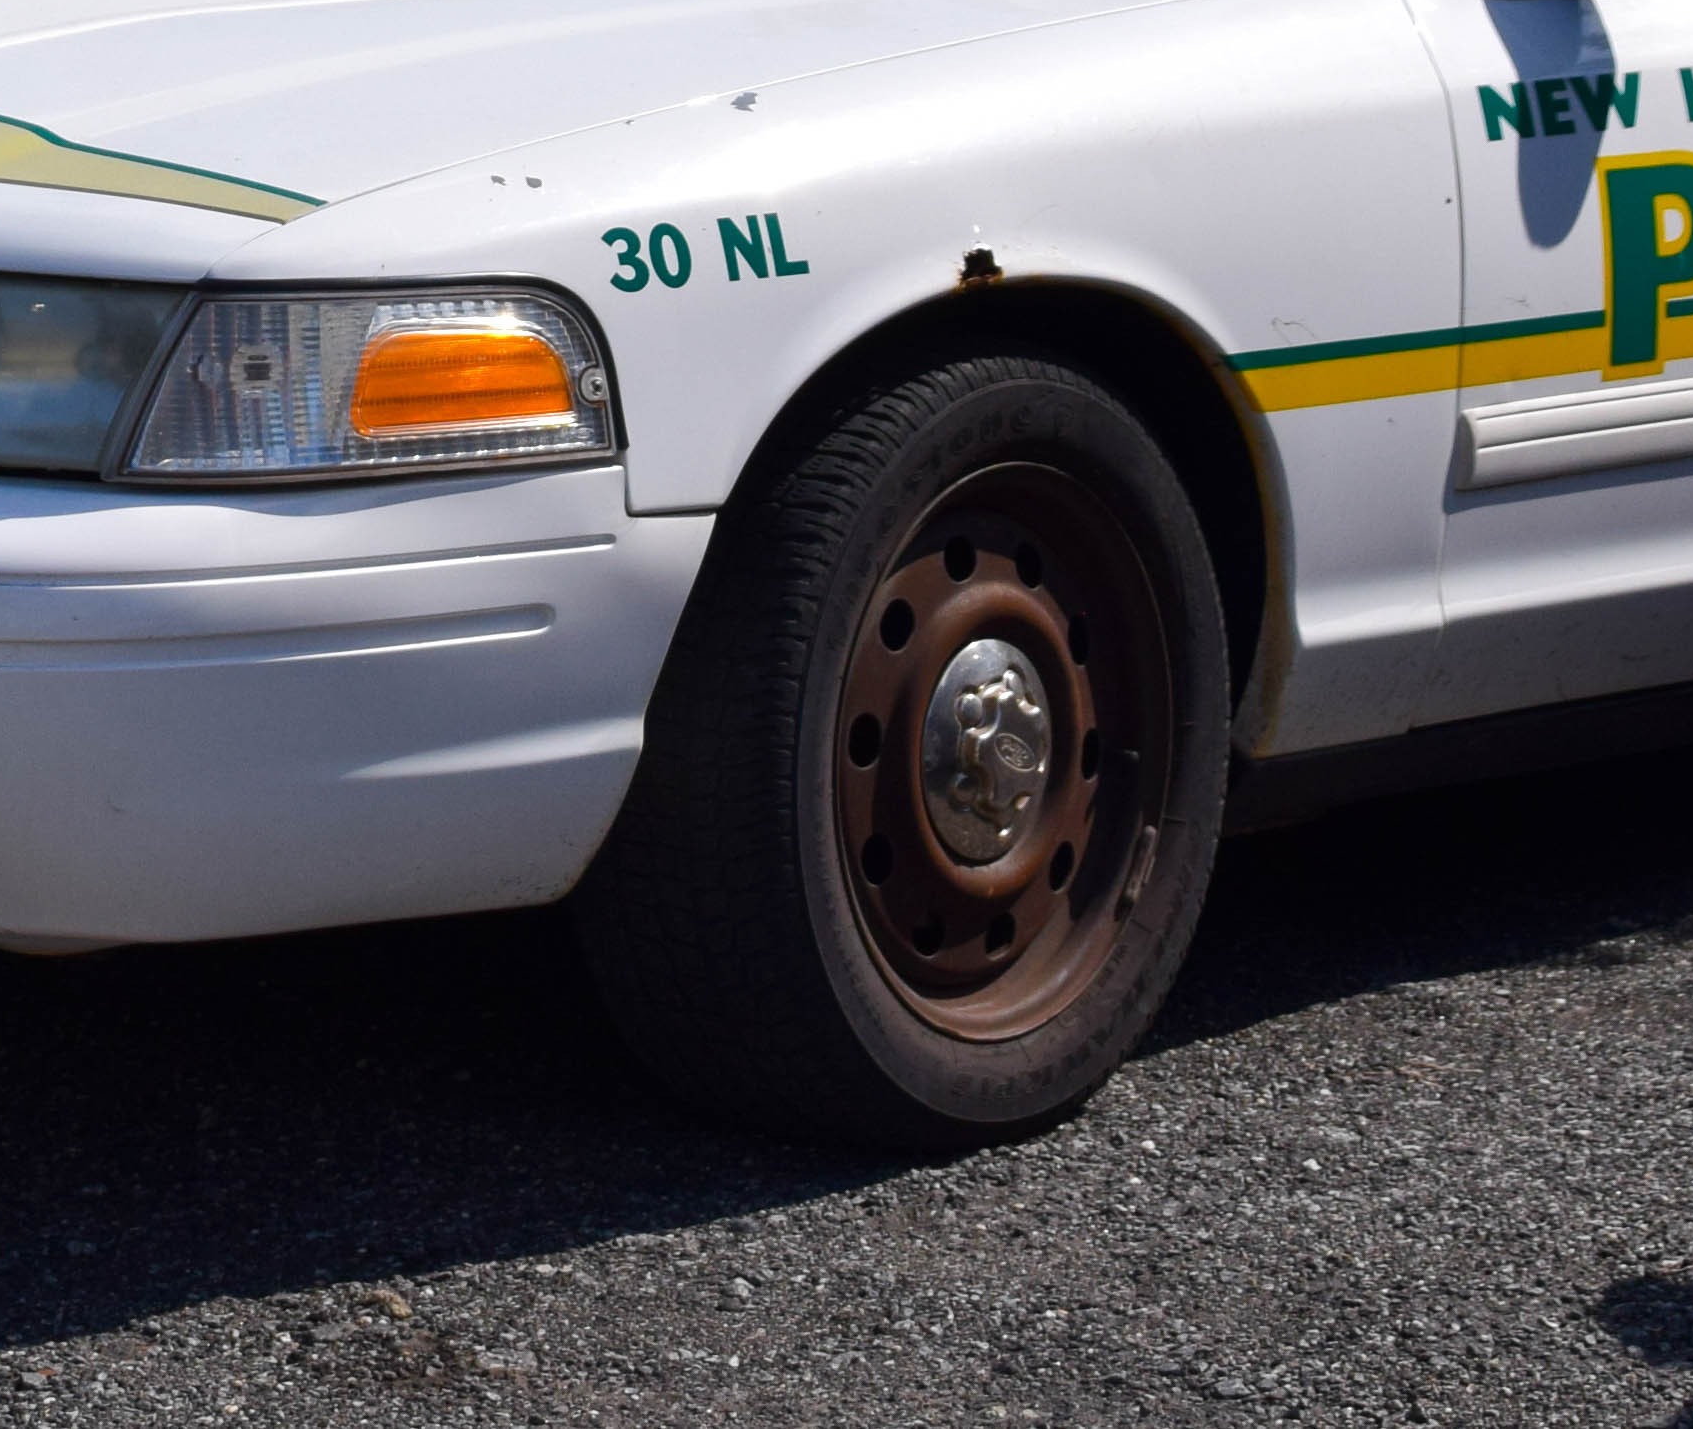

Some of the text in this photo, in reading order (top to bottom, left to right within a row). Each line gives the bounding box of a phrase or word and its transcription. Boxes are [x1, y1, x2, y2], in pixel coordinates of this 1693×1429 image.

[1478, 73, 1640, 142] NEW
[602, 213, 810, 293] 30 NL
